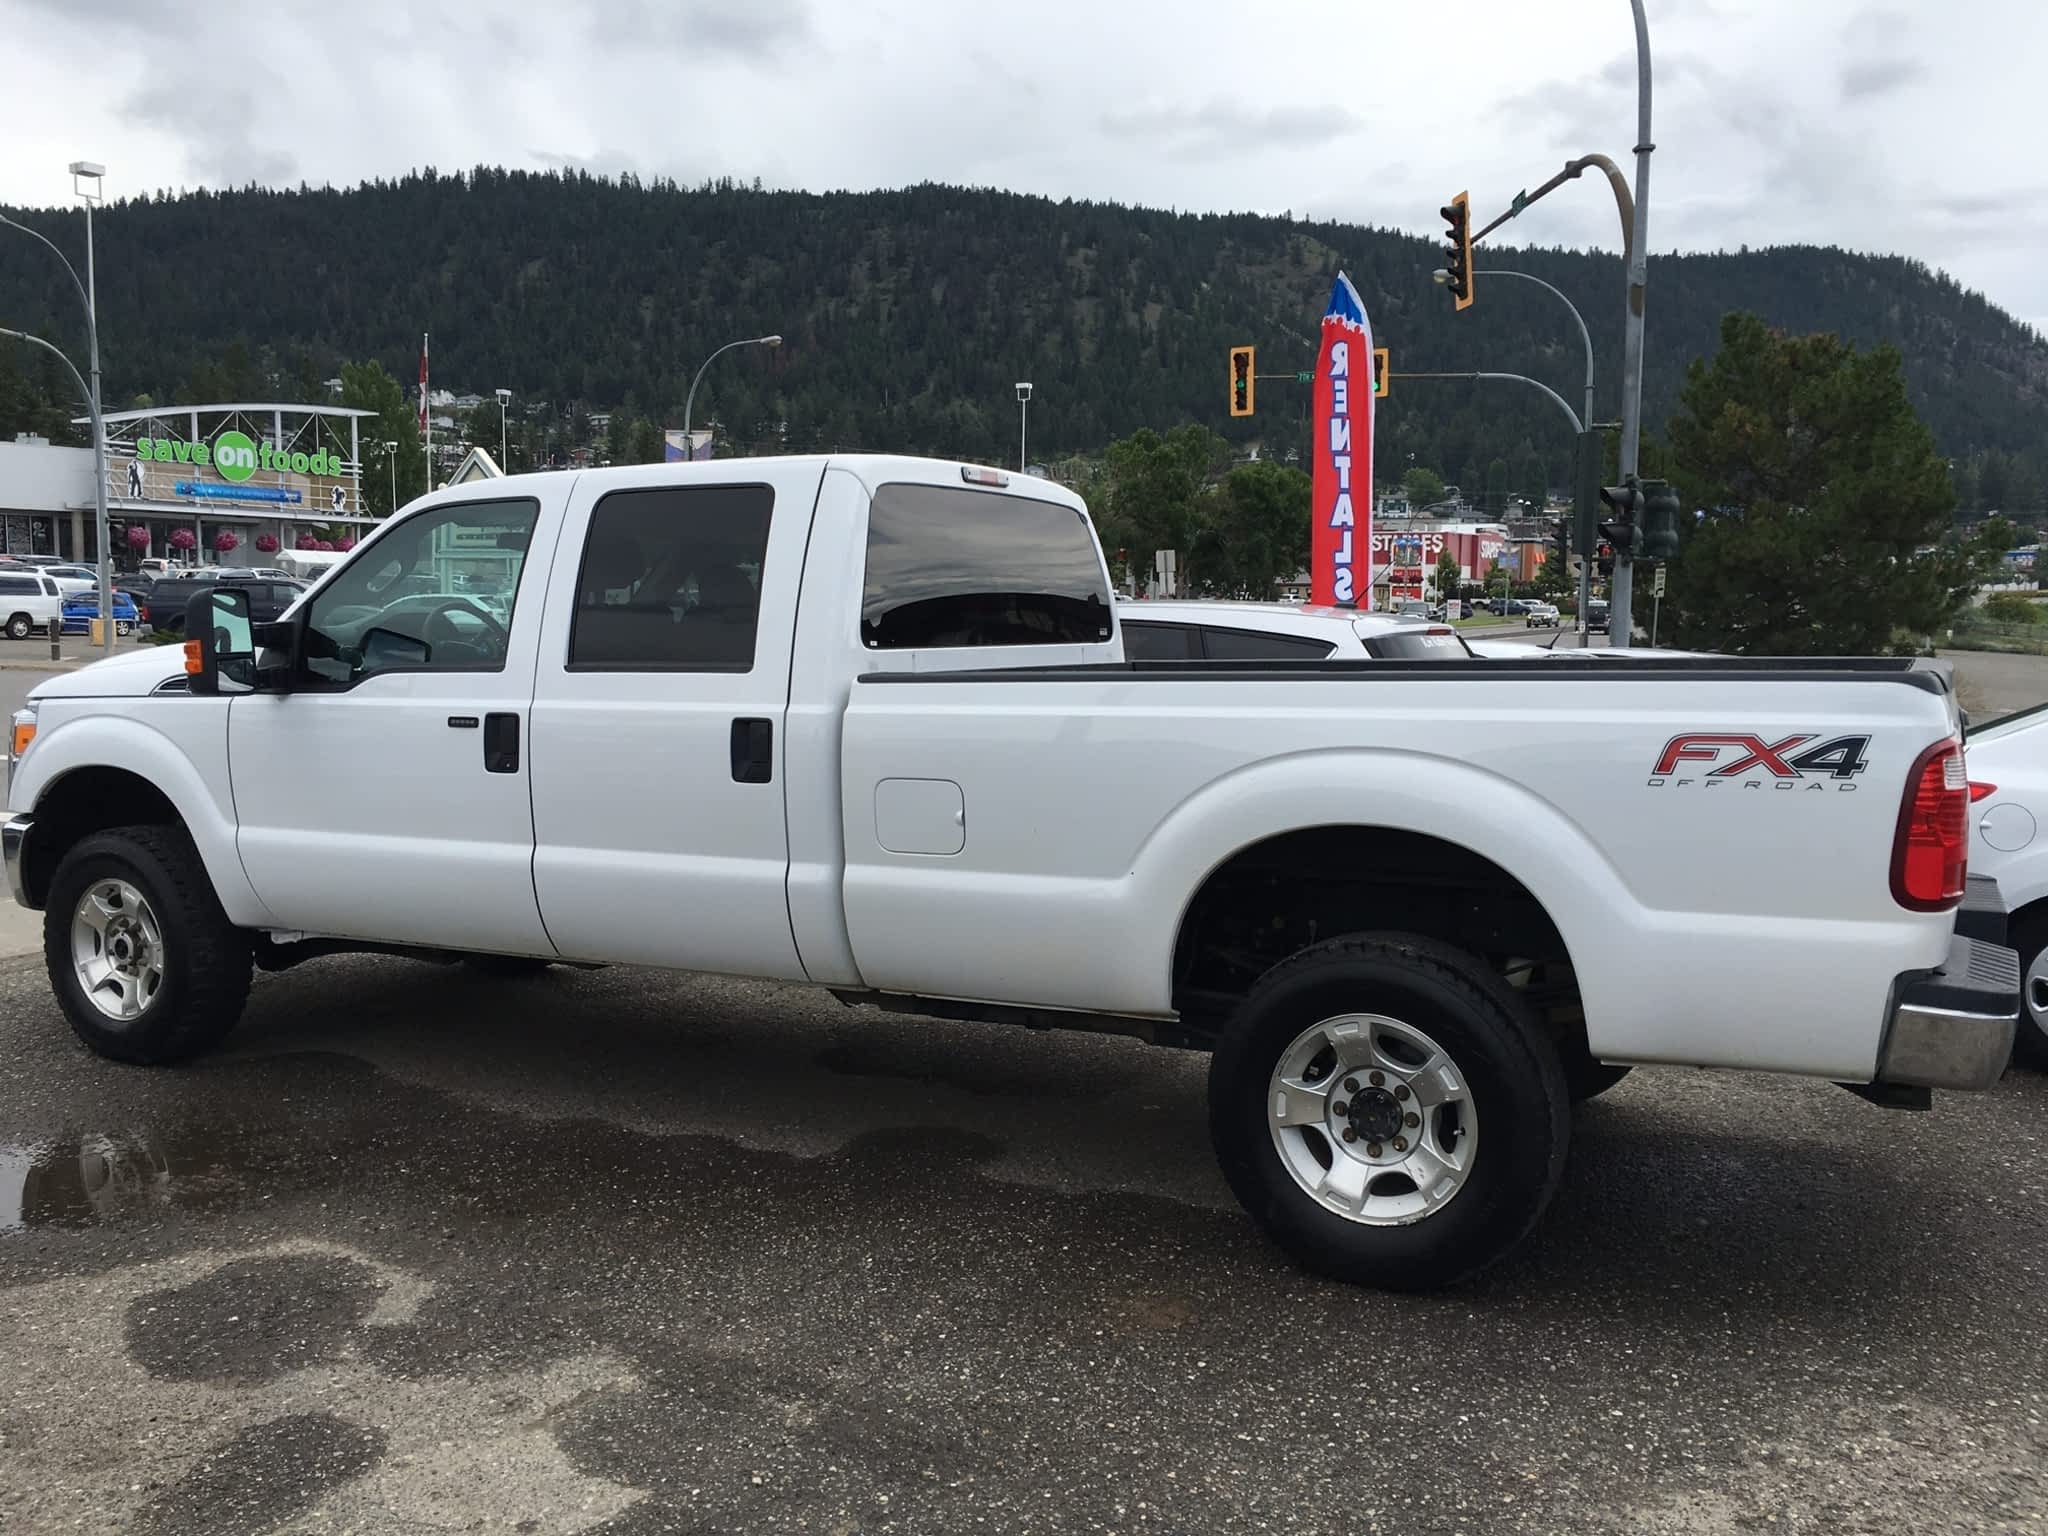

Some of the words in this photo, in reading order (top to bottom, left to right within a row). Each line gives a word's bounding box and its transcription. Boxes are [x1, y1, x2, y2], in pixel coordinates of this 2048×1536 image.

[136, 437, 210, 465] save
[218, 446, 254, 468] on
[259, 441, 342, 476] foods
[1372, 534, 1443, 553] STES
[1651, 732, 1873, 779] FX4
